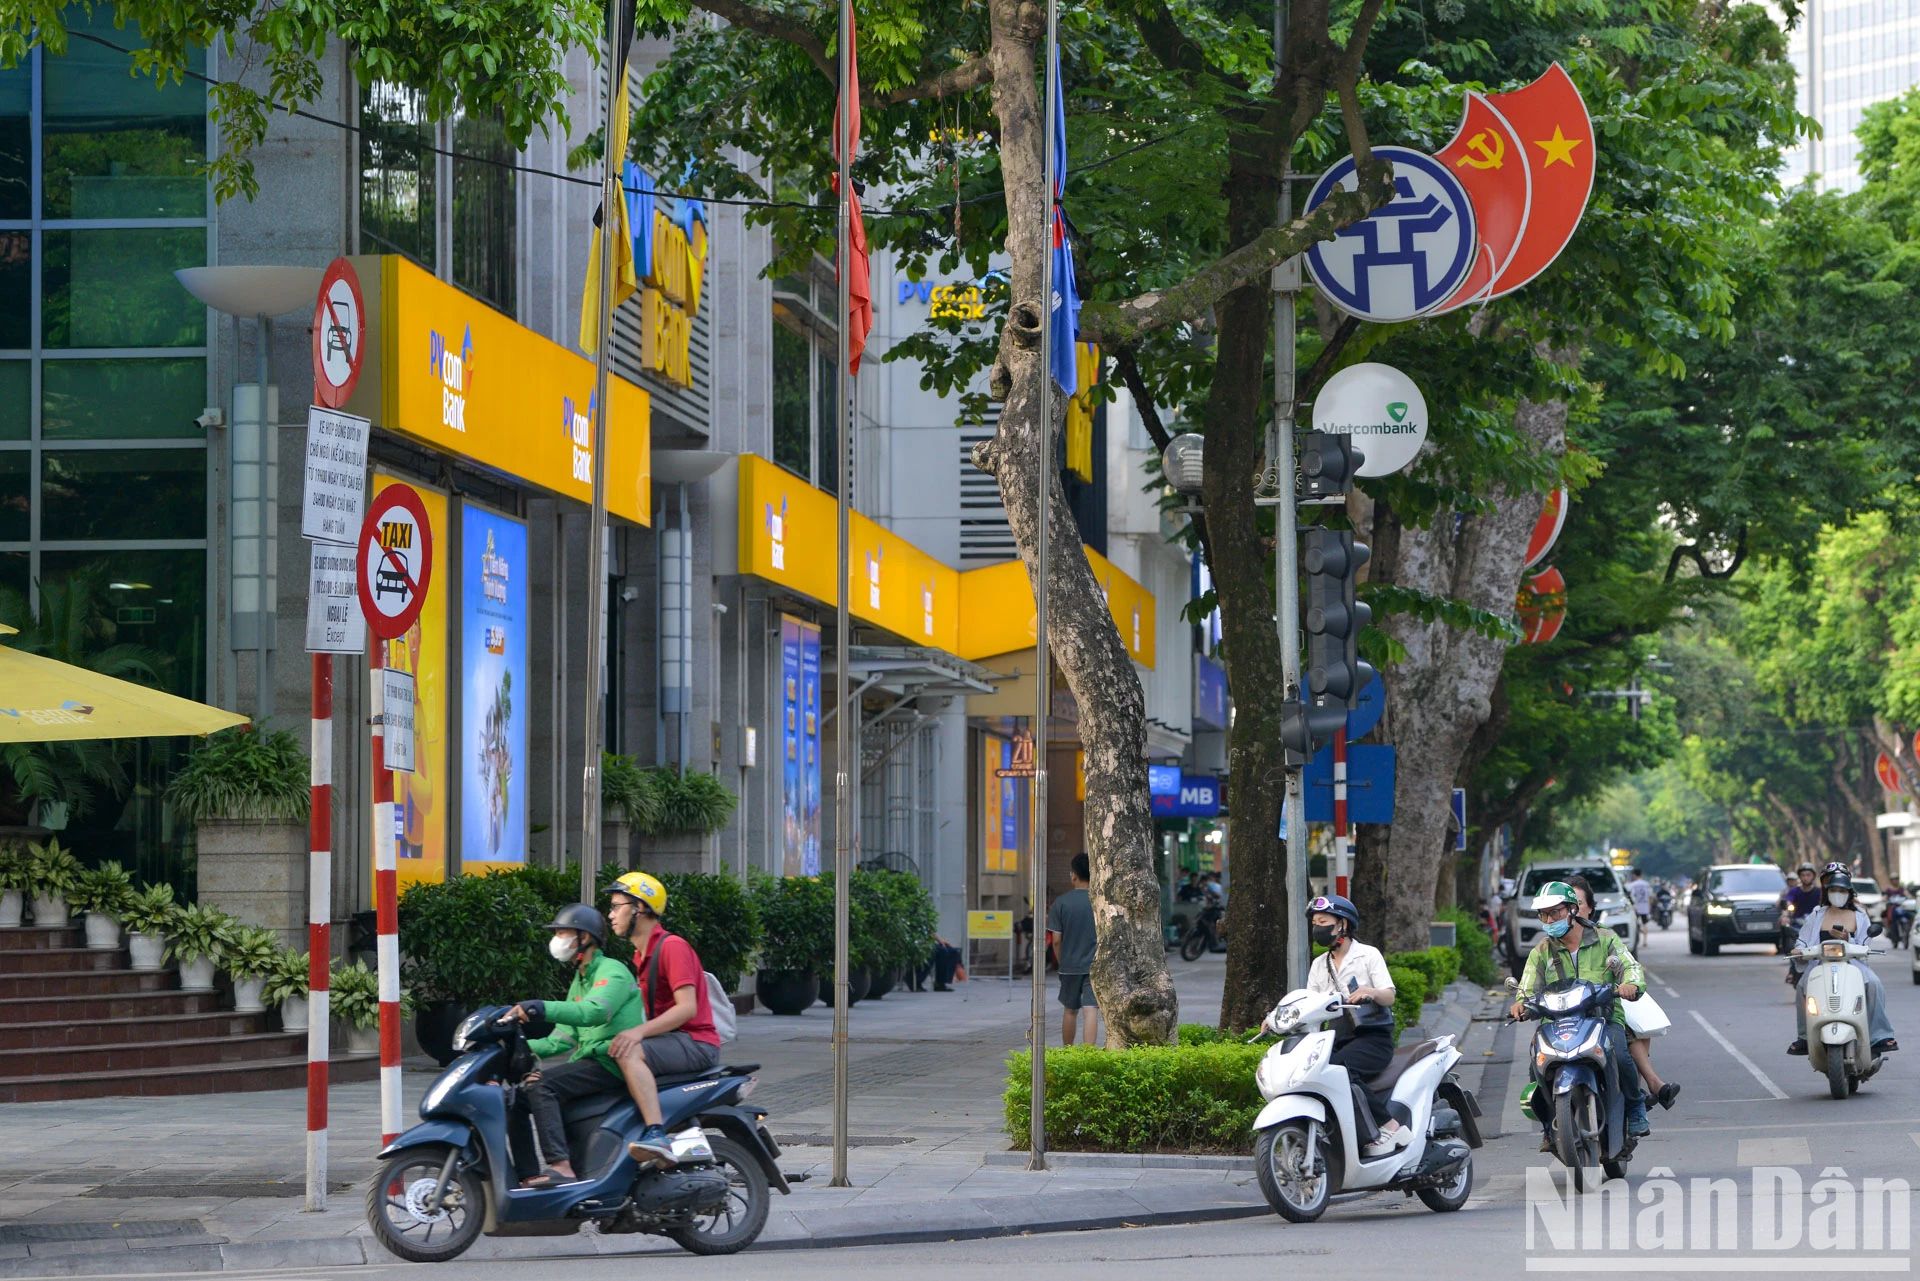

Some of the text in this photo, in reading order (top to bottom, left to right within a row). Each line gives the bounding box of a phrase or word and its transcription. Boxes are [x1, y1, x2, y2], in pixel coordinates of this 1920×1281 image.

[641, 288, 693, 389] Bank
[443, 386, 466, 433] Bank
[1323, 422, 1417, 434] Vietcombank
[572, 444, 592, 484] Bank
[382, 522, 412, 548] TAXI
[326, 627, 346, 646] Except
[1180, 787, 1213, 805] MB
[640, 881, 655, 897] be
